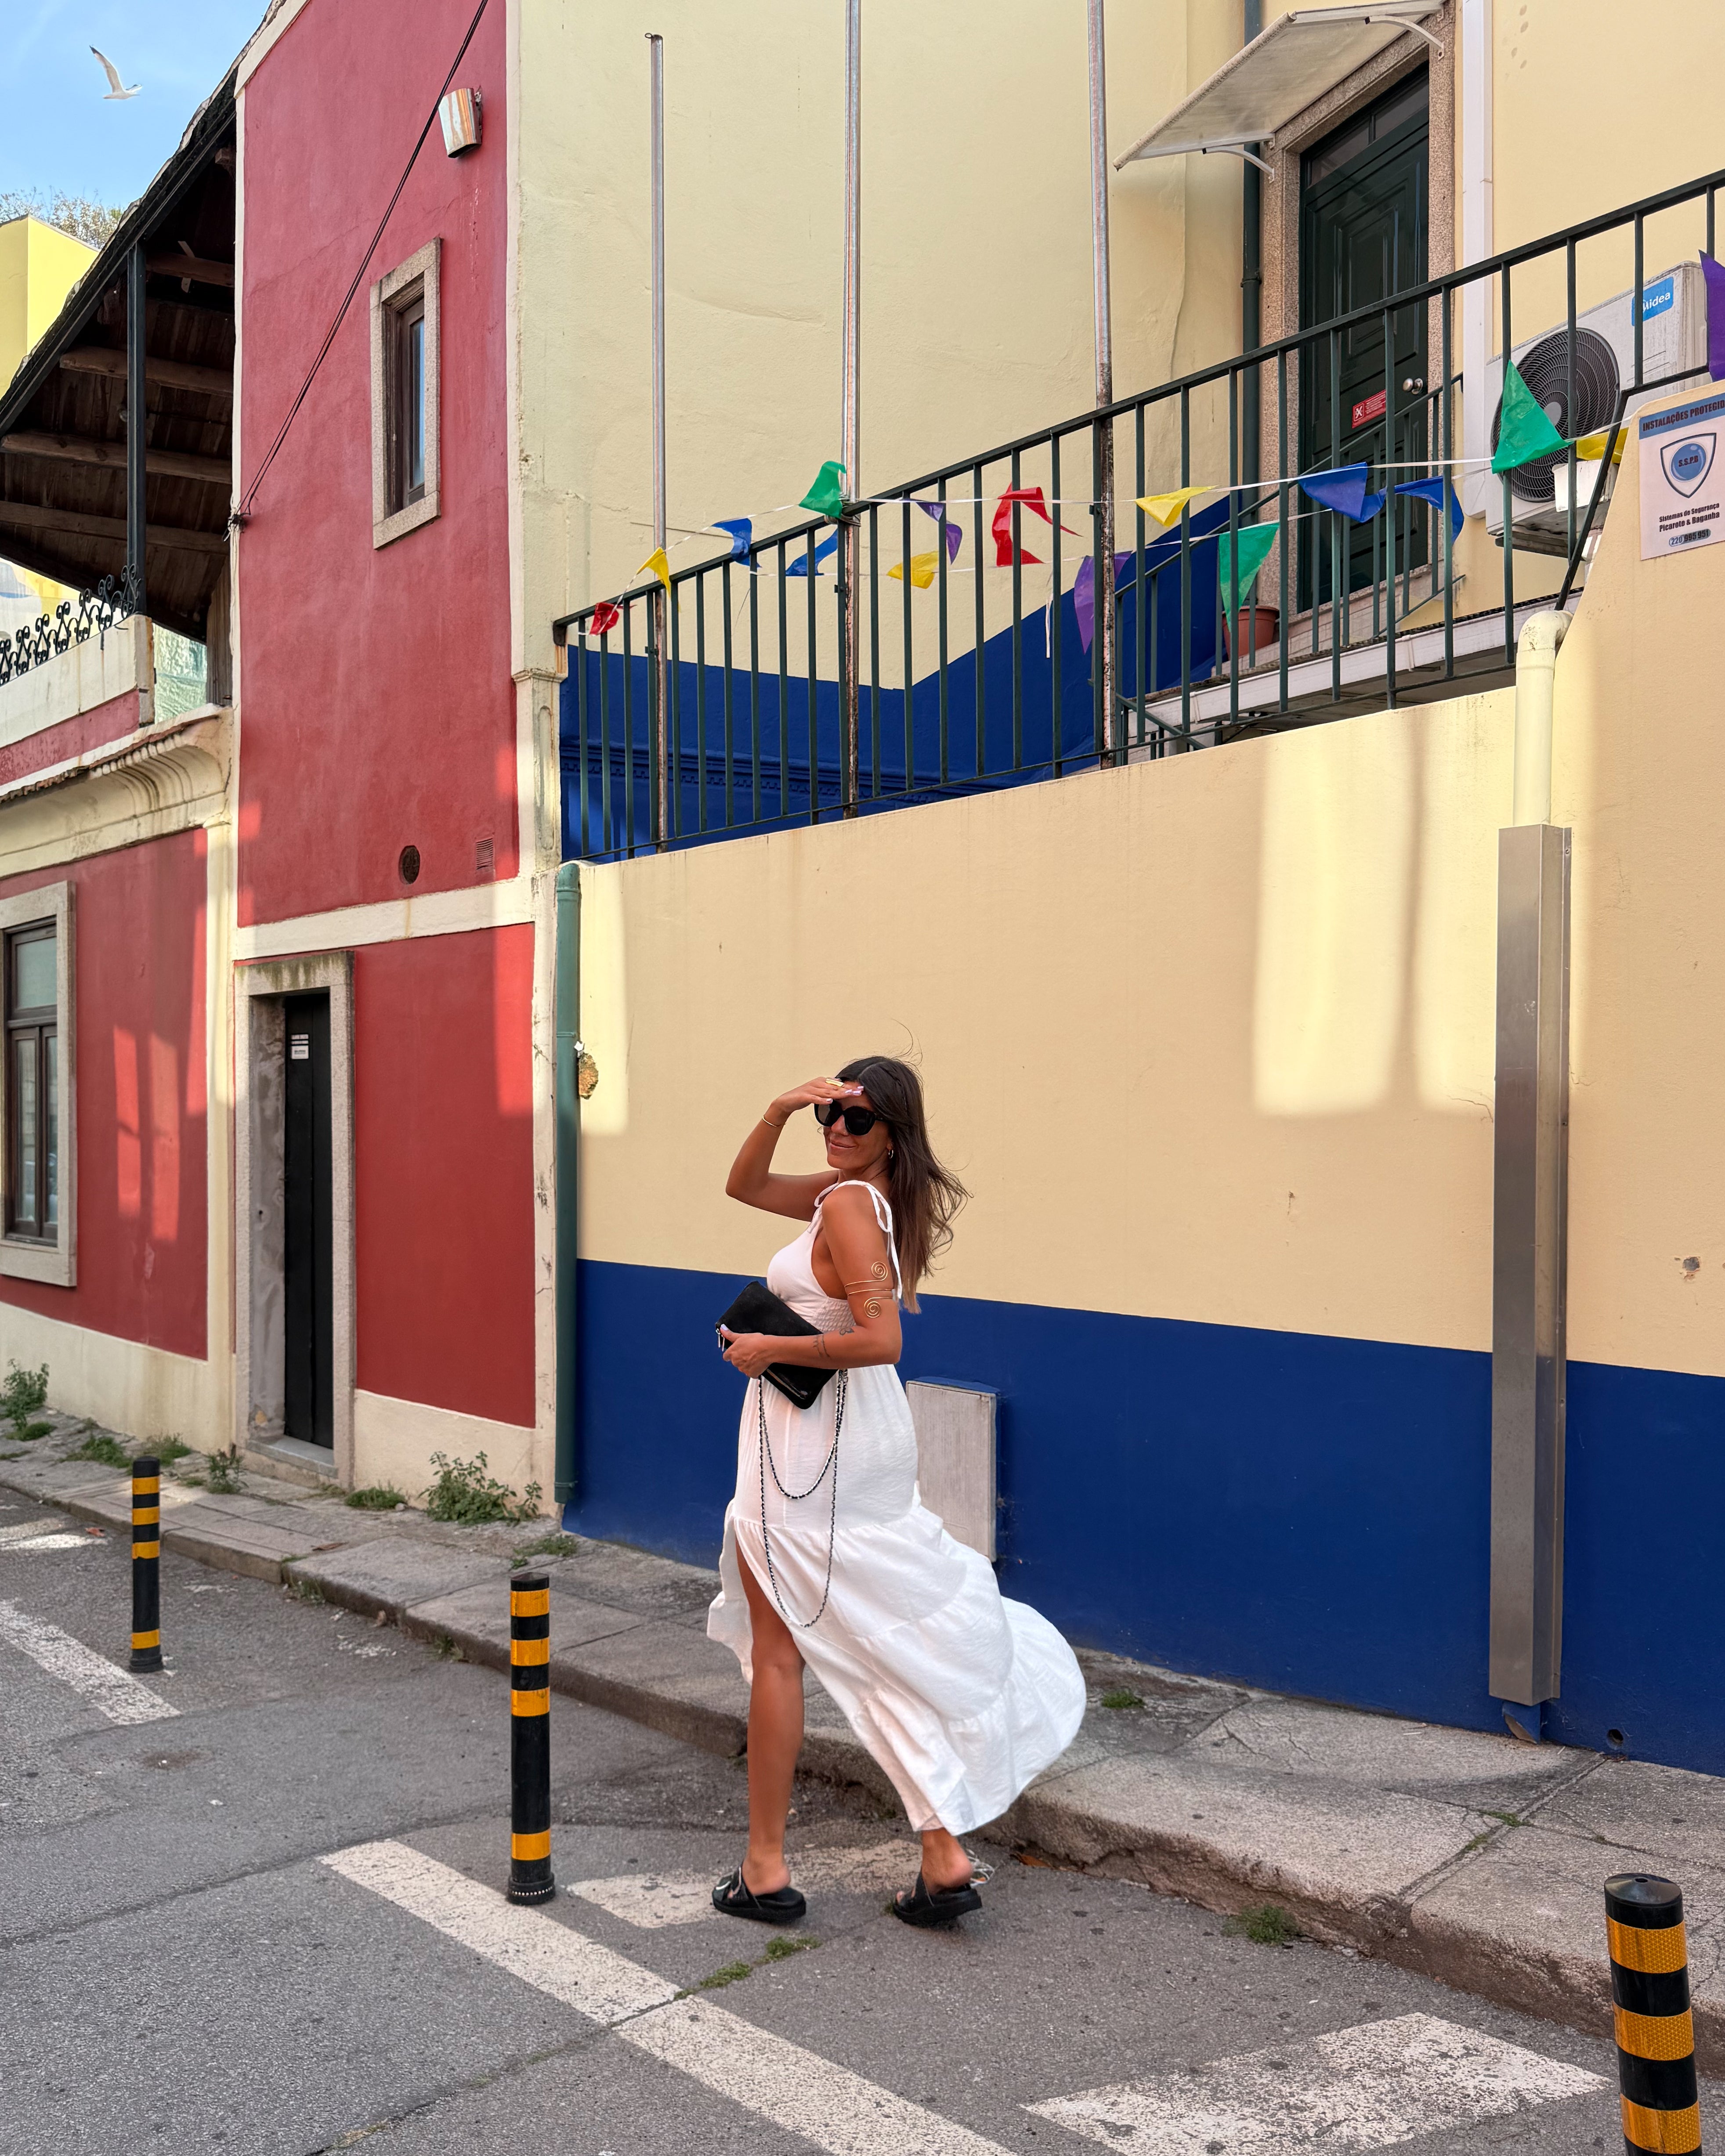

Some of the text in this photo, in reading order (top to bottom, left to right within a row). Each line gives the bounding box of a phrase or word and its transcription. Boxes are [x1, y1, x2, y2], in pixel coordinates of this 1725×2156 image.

[1643, 410, 1688, 431] INSTALAÇÕES
[1678, 455, 1699, 467] S.S.P.B
[1659, 512, 1683, 522] Sistemas
[1691, 503, 1719, 514] Segurança
[1692, 512, 1720, 524] Baganha
[1671, 529, 1709, 545] 220 995 951
